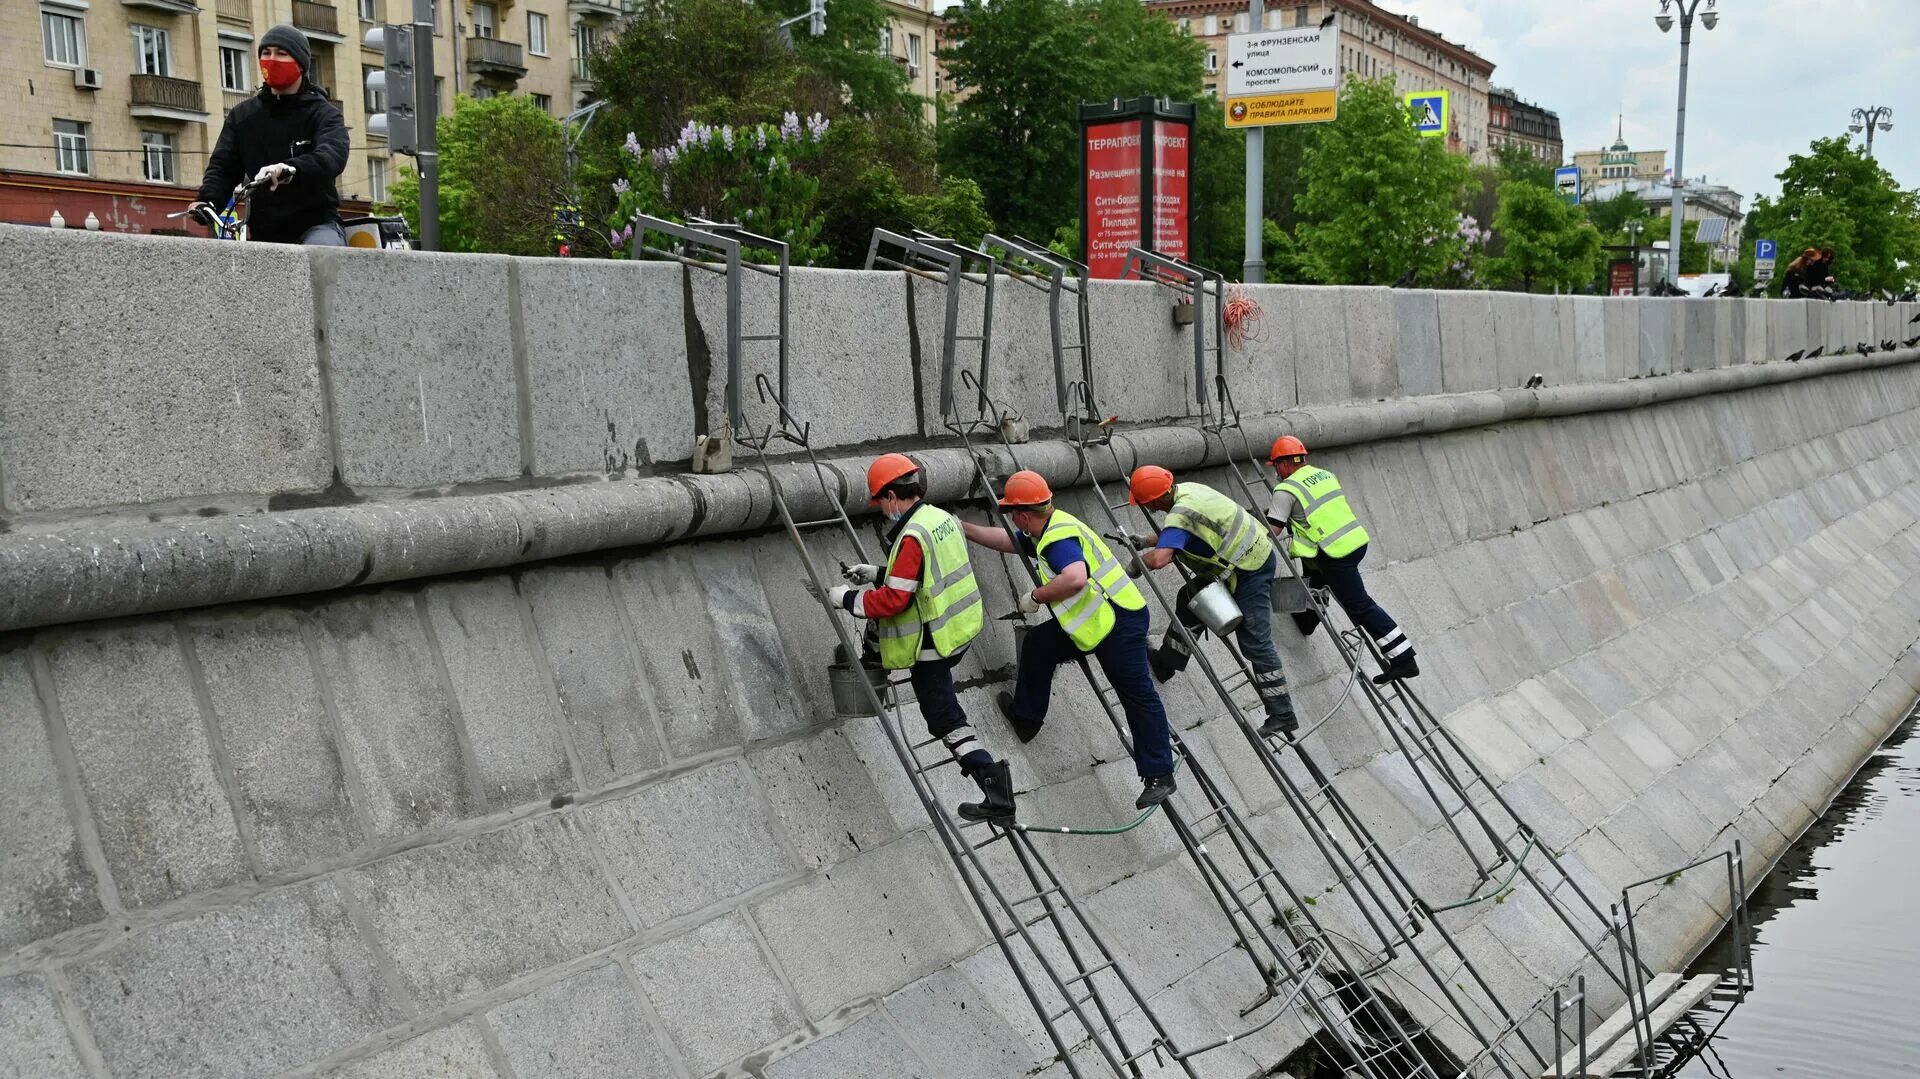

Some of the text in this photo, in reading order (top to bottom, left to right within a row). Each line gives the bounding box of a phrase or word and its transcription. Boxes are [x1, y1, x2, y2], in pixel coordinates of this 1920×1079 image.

[1260, 35, 1320, 47] ФРУНЗЕНСКАЯ
[1246, 50, 1270, 59] улица
[1245, 63, 1319, 77] КОМСОМОЛЬСКИЙ
[1245, 78, 1280, 87] проспект
[1249, 98, 1304, 110] СОБЛЮДАЙТЕ
[1249, 106, 1333, 119] ПРАВИЛА ПАРКОВКИ!
[1095, 194, 1140, 207] Сити-борда
